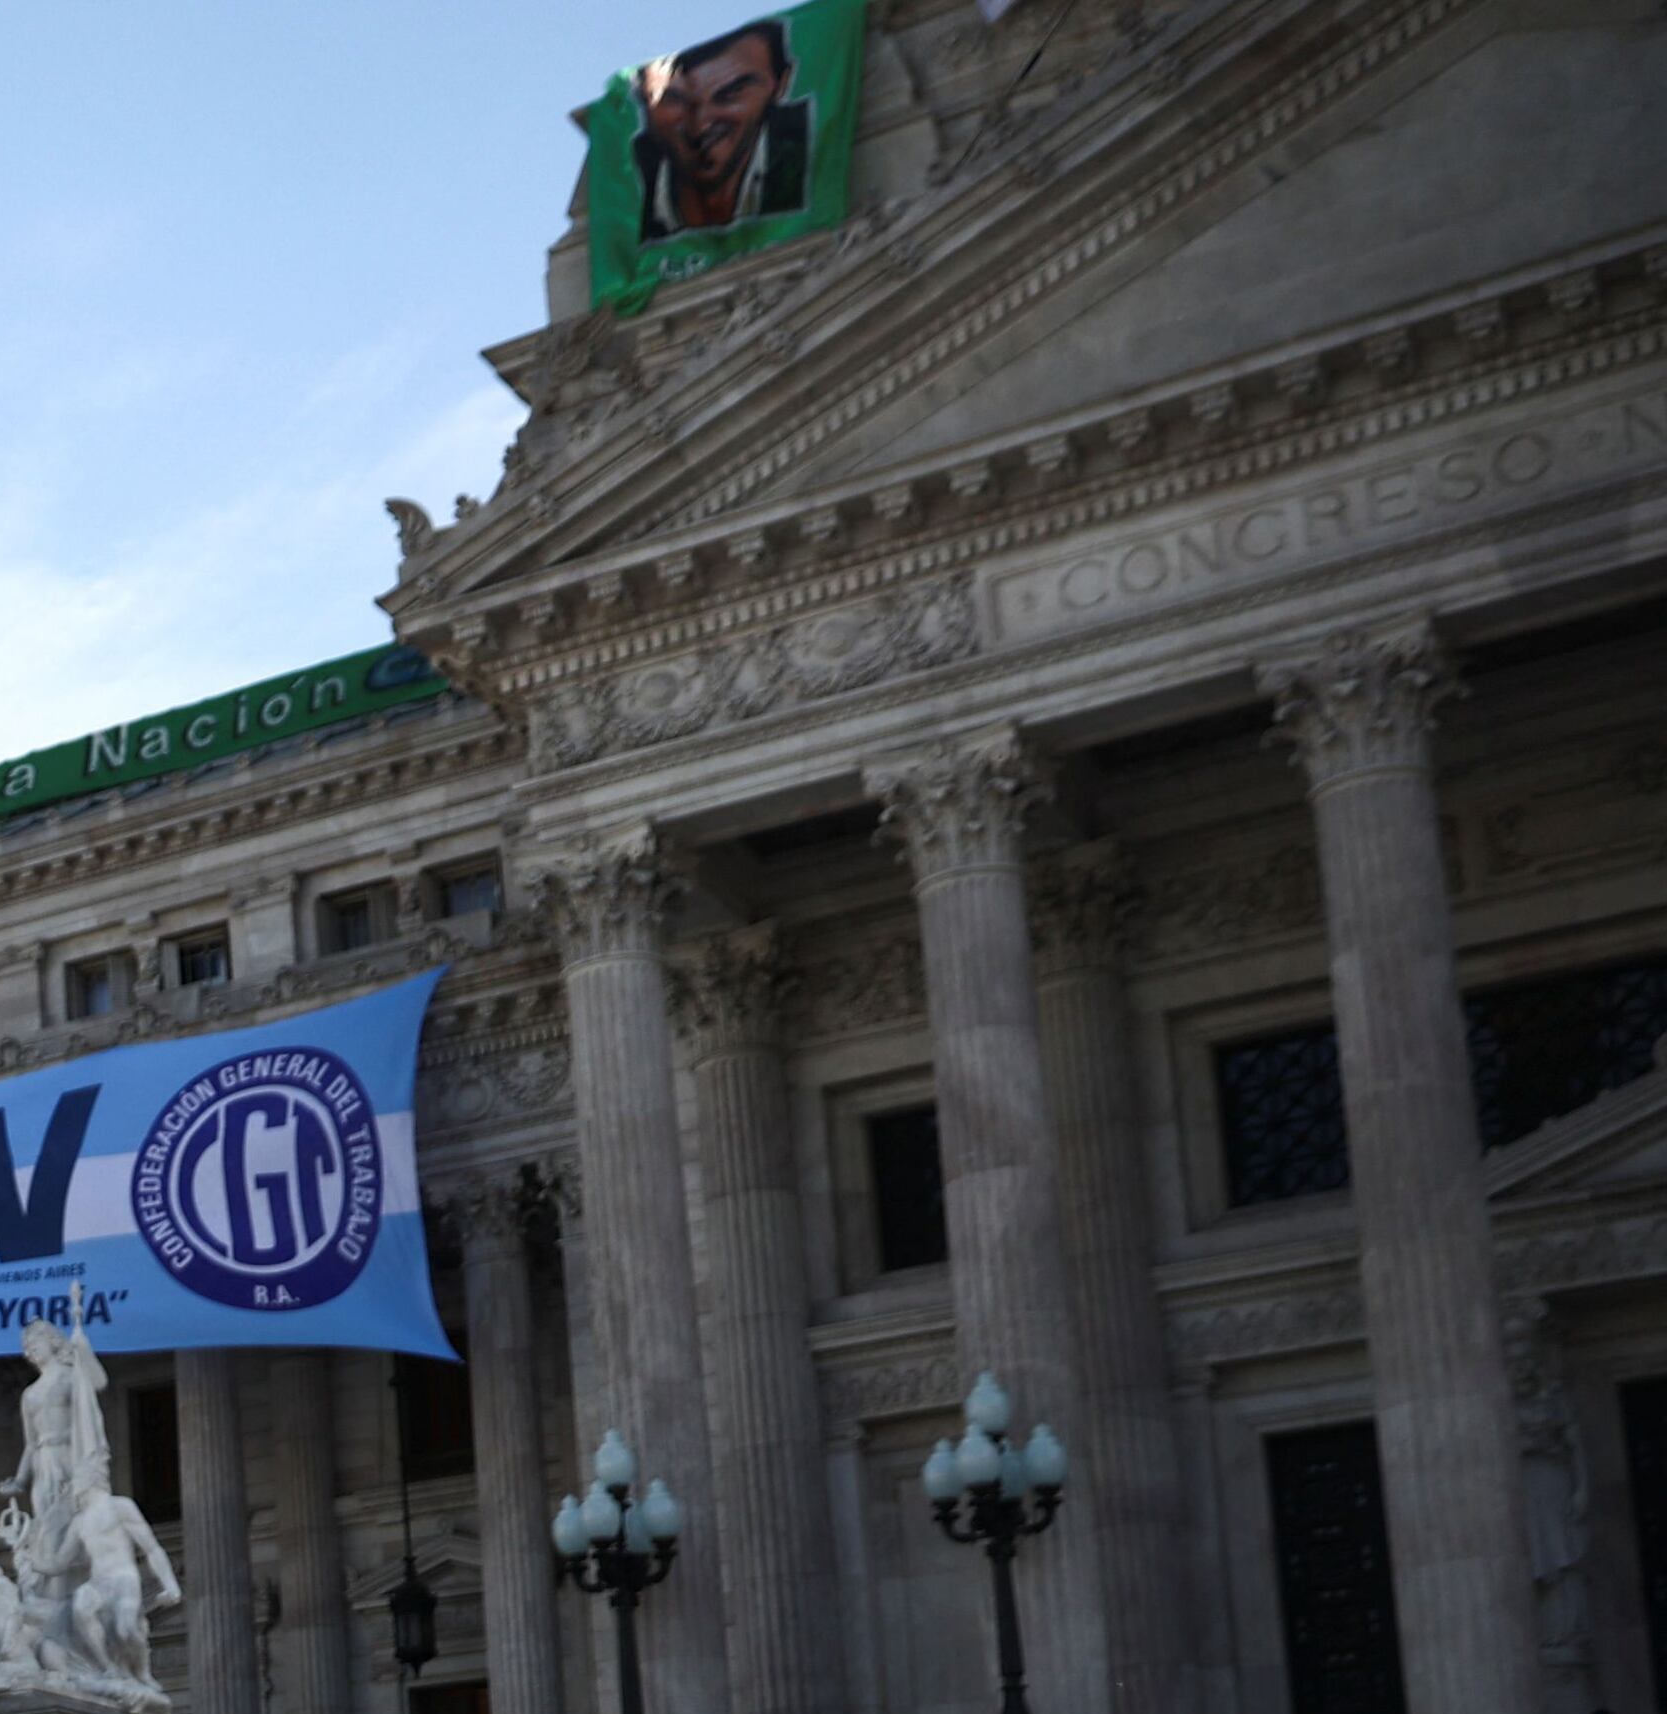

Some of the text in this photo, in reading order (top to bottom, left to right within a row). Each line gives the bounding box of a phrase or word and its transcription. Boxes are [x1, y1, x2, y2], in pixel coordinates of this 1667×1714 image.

[1057, 430, 1554, 609] CONGRESO
[87, 675, 346, 773] Nación
[219, 1053, 329, 1089] GENERAL
[326, 1075, 362, 1124] DEL
[178, 1091, 335, 1265] CGT
[338, 1124, 375, 1262] TRABAJO
[44, 1262, 86, 1279] AIRES
[253, 1285, 300, 1304] R.A.
